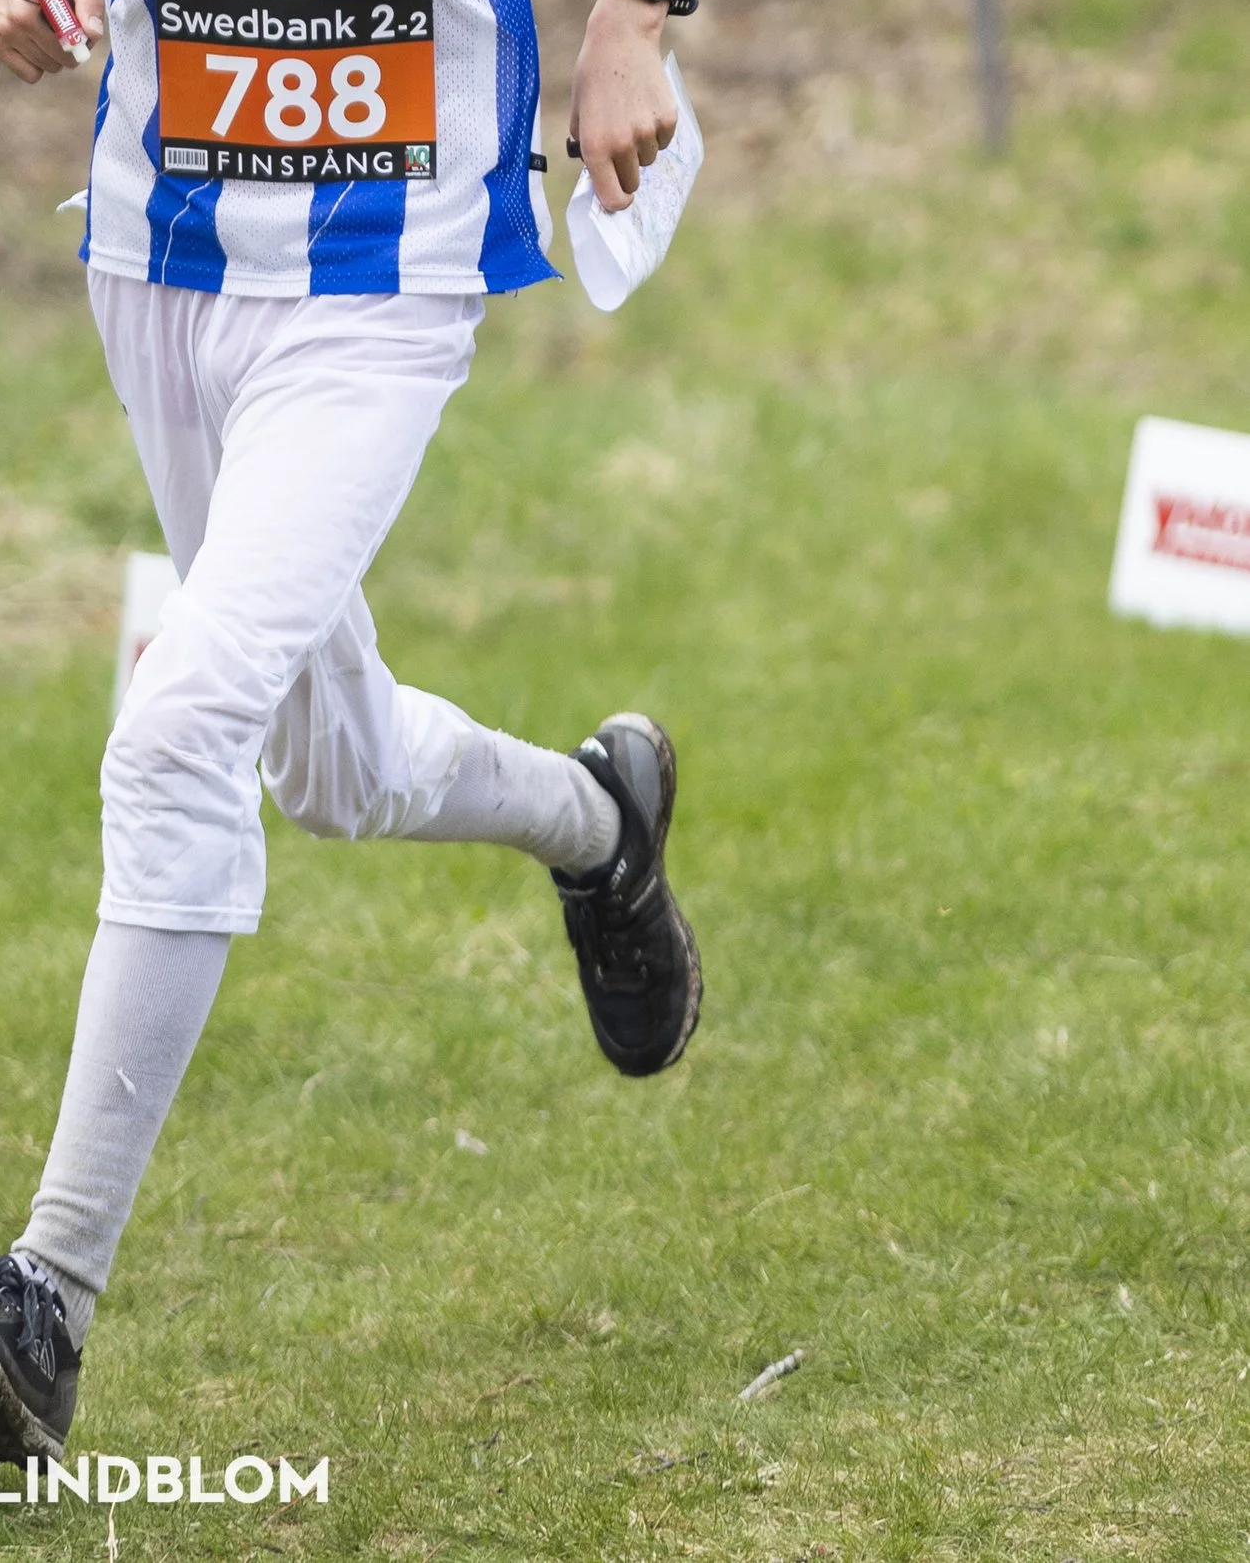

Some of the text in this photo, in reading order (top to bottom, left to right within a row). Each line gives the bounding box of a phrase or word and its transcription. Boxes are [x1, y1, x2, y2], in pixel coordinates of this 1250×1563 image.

[161, 1, 428, 42] Swedbank 2-2
[205, 53, 387, 142] 788
[217, 147, 394, 176] FINSPÅNG
